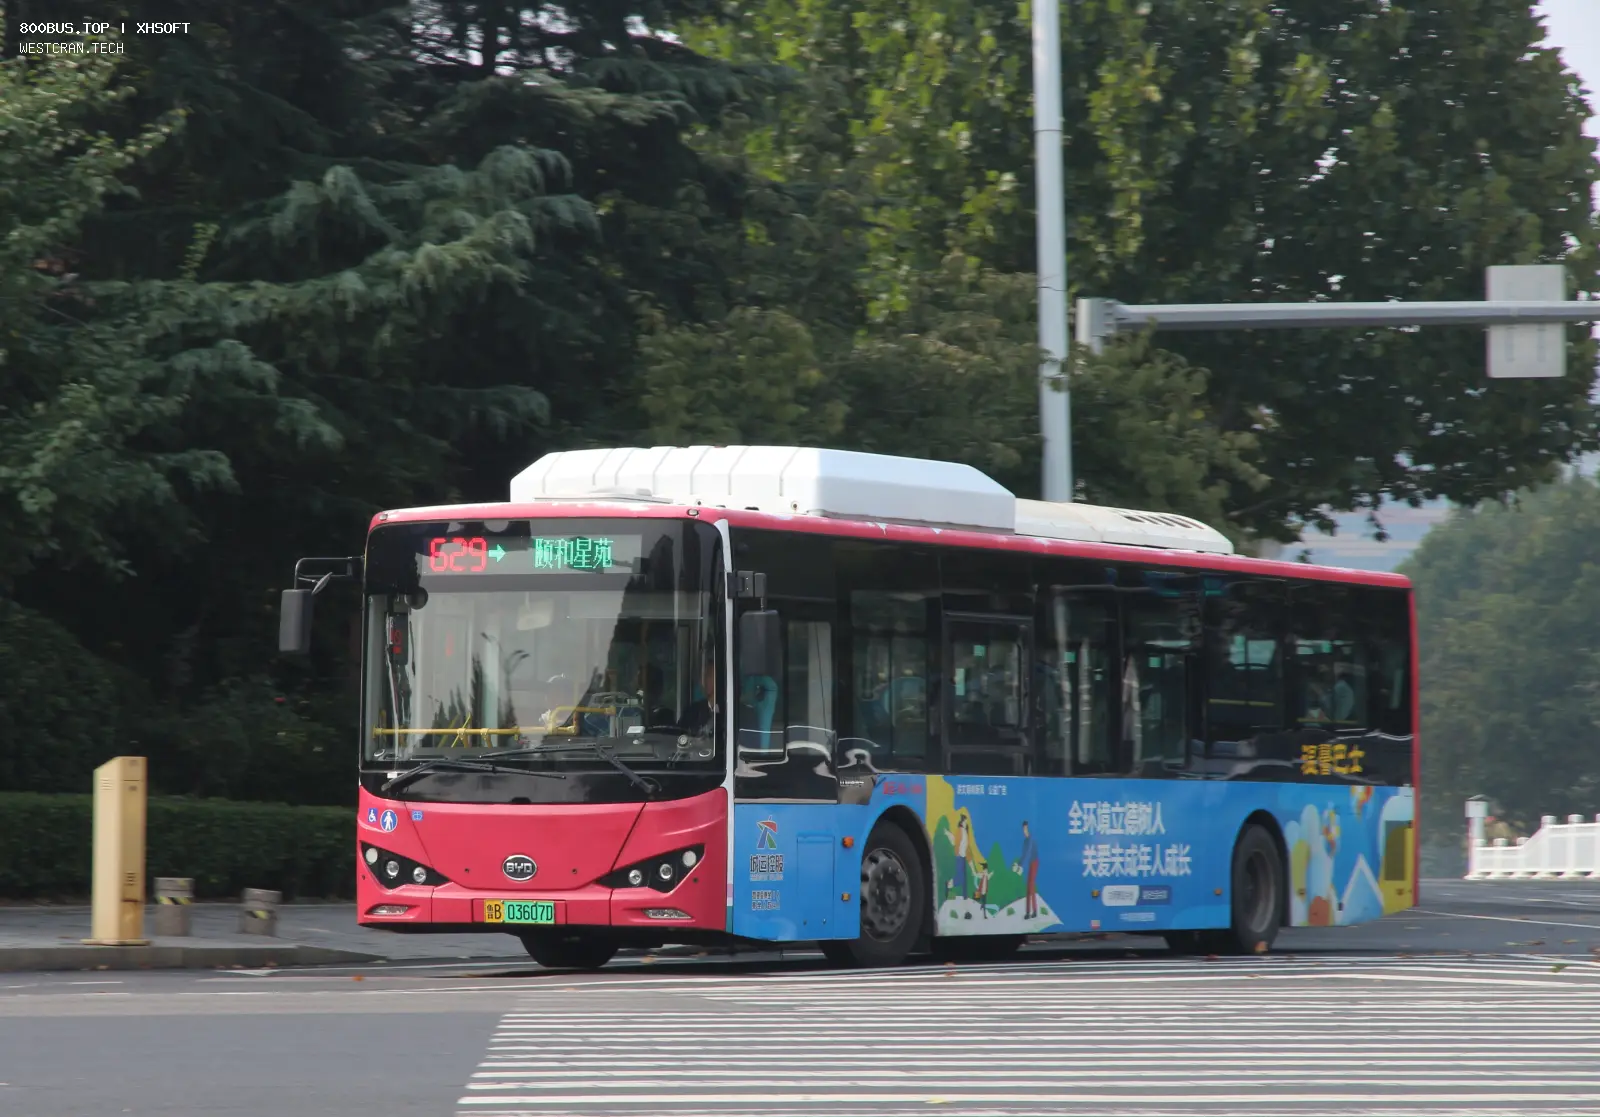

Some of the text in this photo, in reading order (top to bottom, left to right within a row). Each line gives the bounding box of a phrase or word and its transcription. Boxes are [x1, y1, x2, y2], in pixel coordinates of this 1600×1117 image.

[430, 537, 487, 572] 629
[534, 538, 614, 569] 颐和星苑
[1068, 800, 1166, 835] 全环境立德树人
[506, 862, 533, 873] BYD
[1082, 843, 1192, 877] 关爱未成年人成长
[507, 904, 553, 921] 03607D
